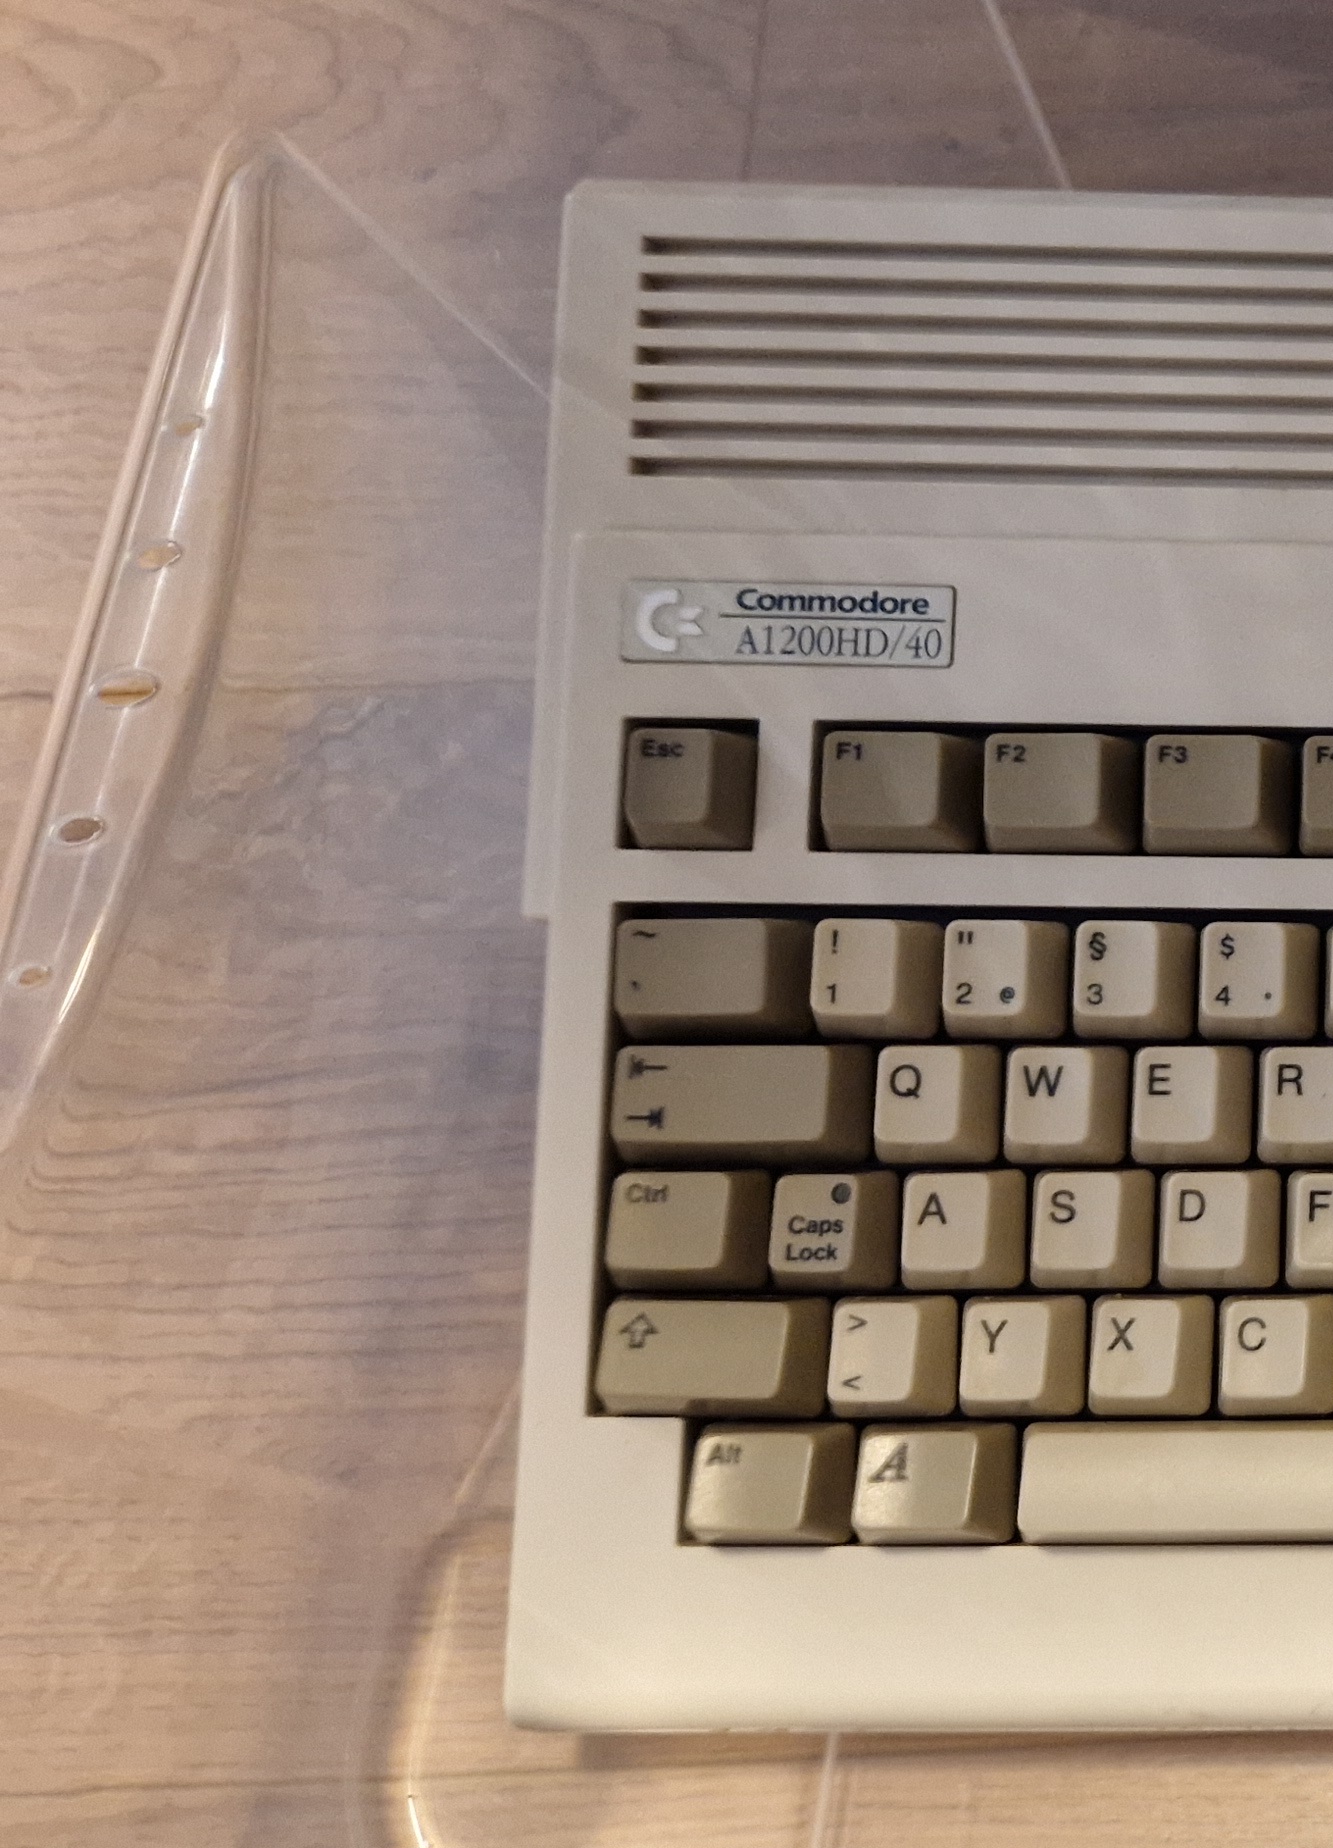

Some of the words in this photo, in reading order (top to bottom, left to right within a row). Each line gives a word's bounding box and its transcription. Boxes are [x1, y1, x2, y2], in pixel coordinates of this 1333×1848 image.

[736, 589, 930, 615] Commodore
[737, 626, 942, 658] A1200HD/40
[640, 738, 682, 758] Esc
[836, 742, 862, 760] F1
[996, 744, 1026, 762] F2
[1158, 745, 1187, 763] F3
[832, 930, 838, 953] !
[1088, 932, 1106, 961] §
[1221, 934, 1234, 959] $
[827, 984, 836, 1003] 1
[956, 983, 972, 1004] 2
[1087, 983, 1103, 1005] 3
[1215, 986, 1230, 1005] 4
[890, 1065, 921, 1098] Q
[1023, 1066, 1062, 1097] W
[1148, 1064, 1170, 1095] E
[1277, 1064, 1302, 1095] R
[626, 1184, 669, 1203] Ctrl
[918, 1193, 946, 1225] A
[1050, 1190, 1076, 1224] S
[1179, 1190, 1205, 1222] D
[1309, 1190, 1332, 1222] F
[788, 1216, 843, 1237] Caps
[785, 1244, 837, 1261] Lock
[848, 1315, 867, 1331] >
[1108, 1318, 1134, 1351] X
[1238, 1317, 1266, 1352] C
[981, 1320, 1007, 1353] Y
[842, 1376, 861, 1390] <
[708, 1444, 743, 1464] Alt
